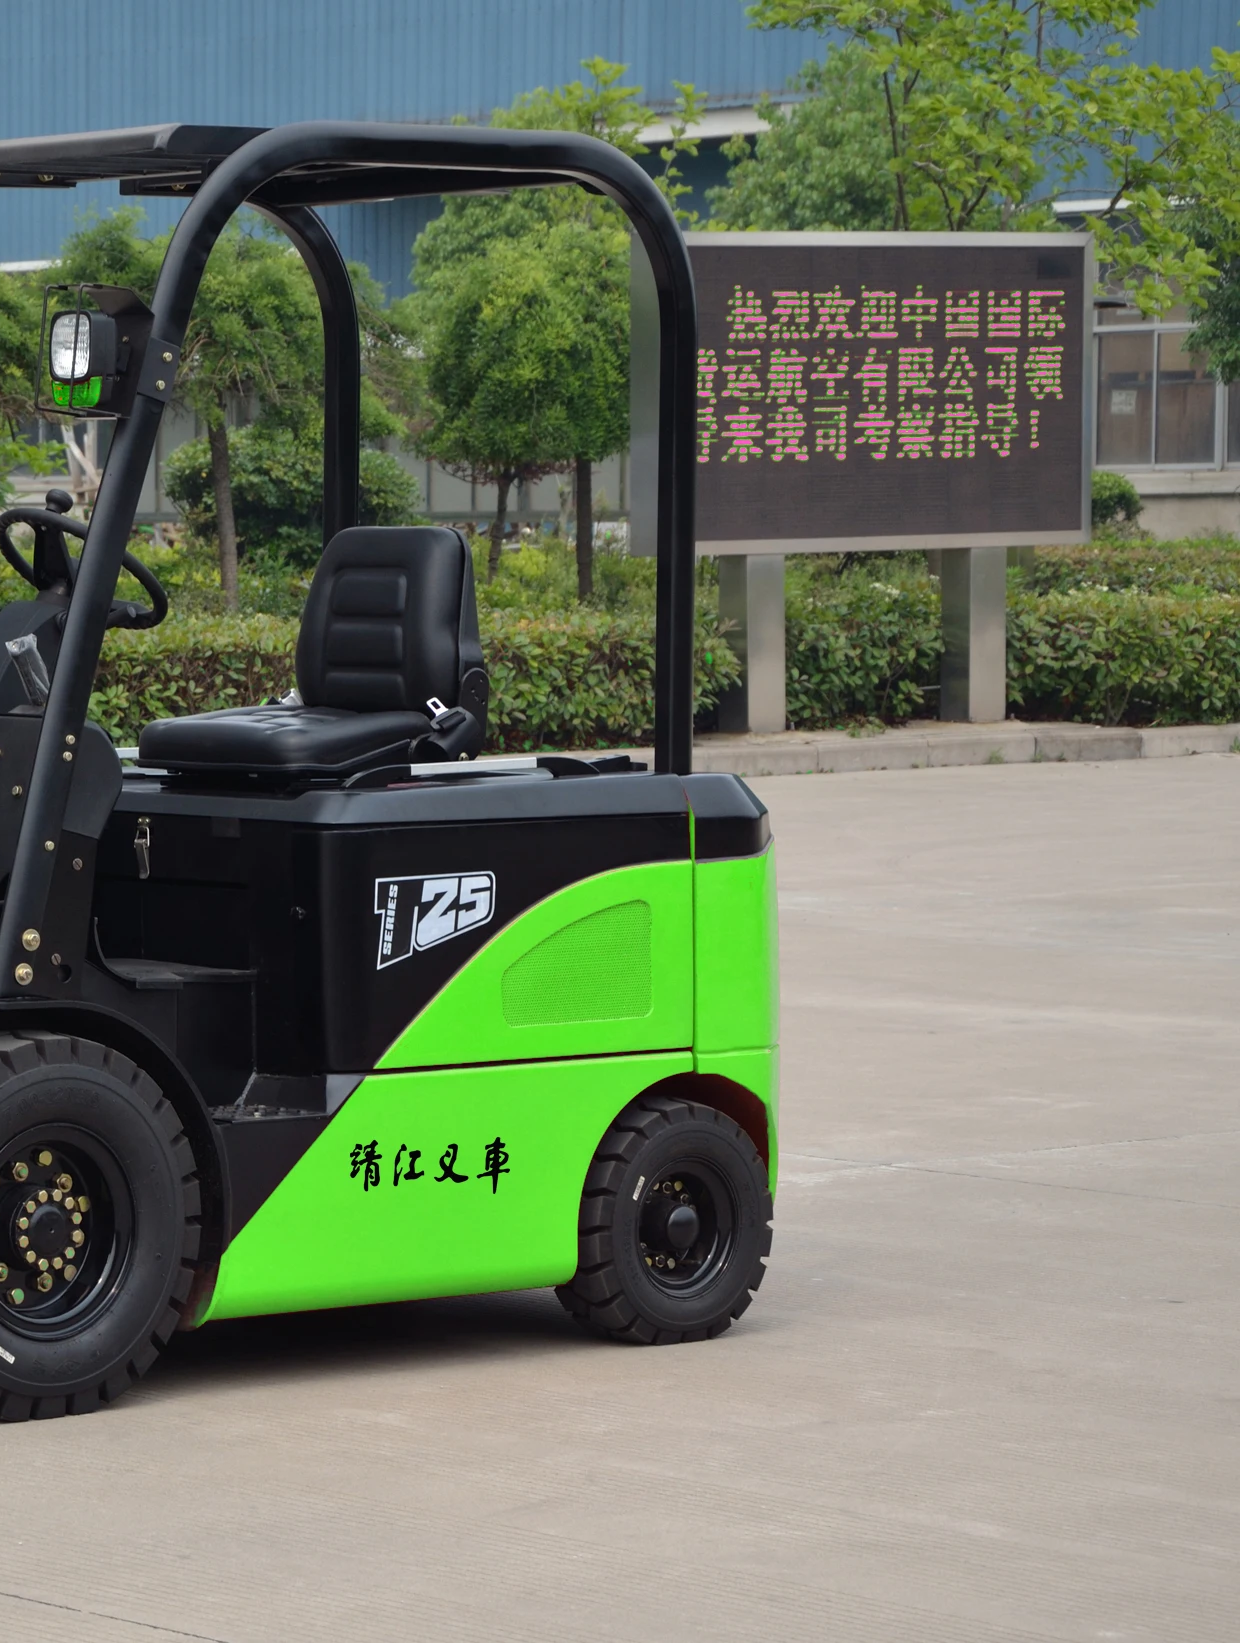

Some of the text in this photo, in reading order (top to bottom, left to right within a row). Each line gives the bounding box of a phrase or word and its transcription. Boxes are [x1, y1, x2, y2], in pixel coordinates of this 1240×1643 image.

[726, 284, 1066, 341] 热烈欢迎中国国际
[382, 884, 399, 956] SERIES
